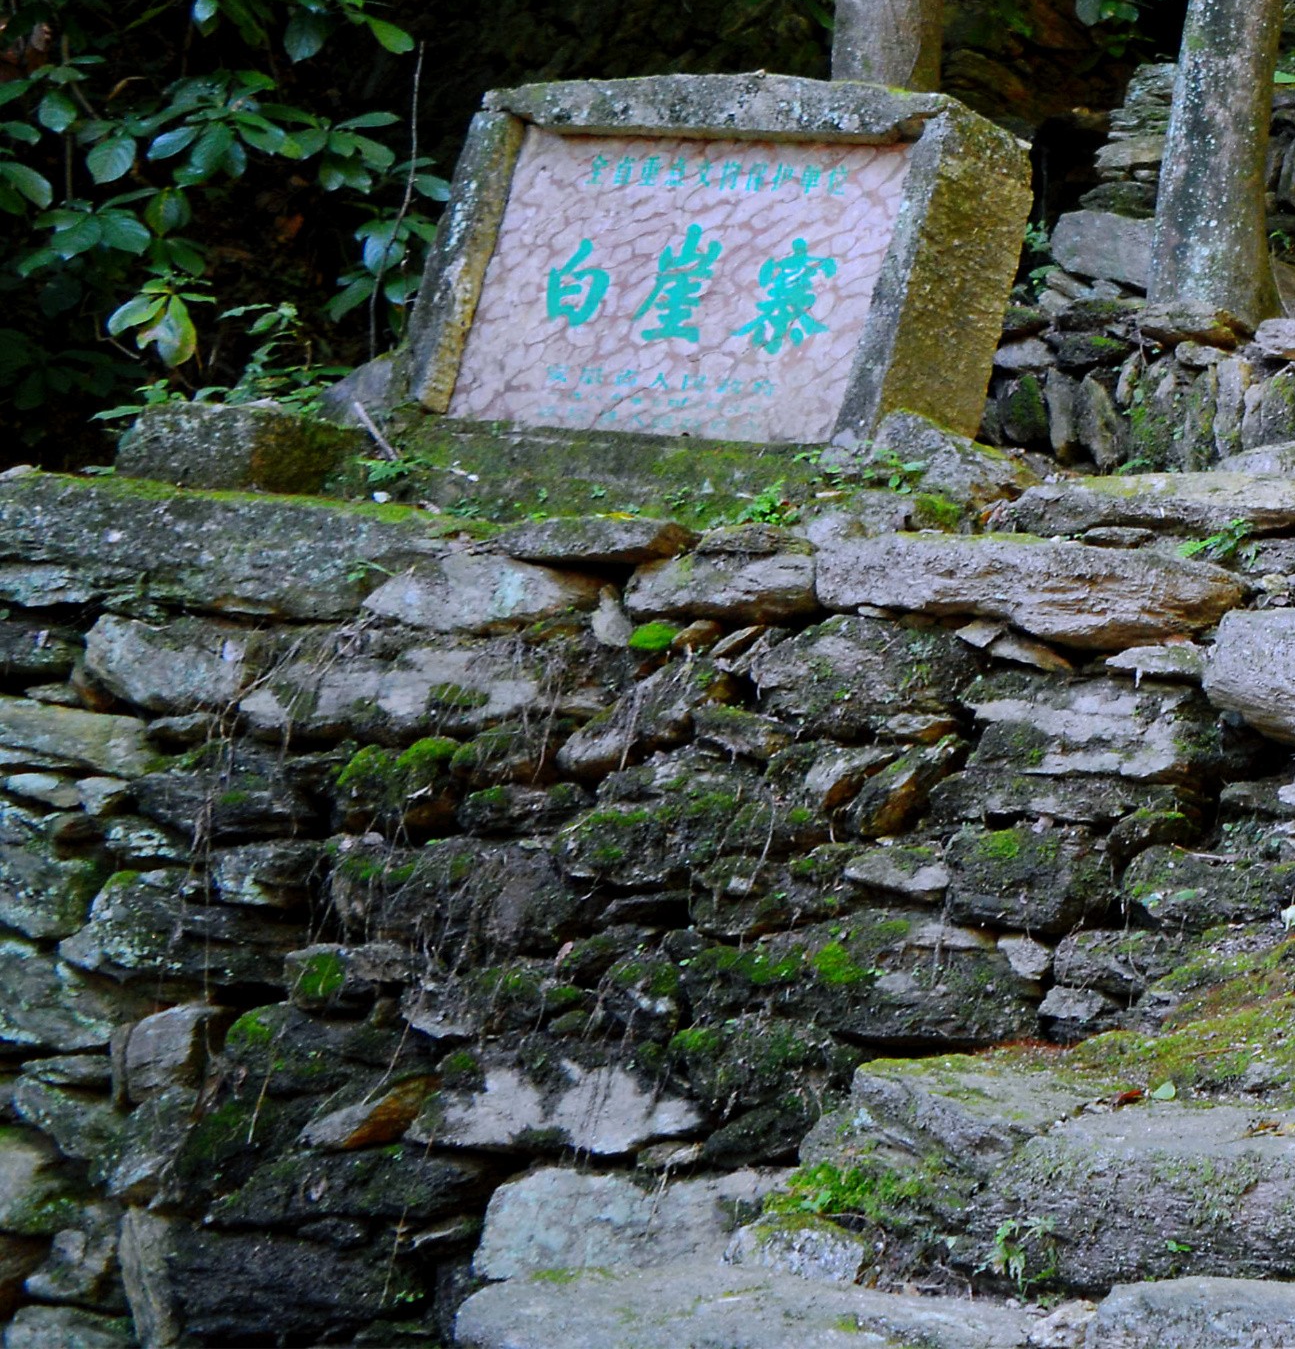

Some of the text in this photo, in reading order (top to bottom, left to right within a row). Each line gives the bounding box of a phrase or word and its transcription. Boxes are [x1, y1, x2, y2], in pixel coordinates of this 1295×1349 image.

[585, 153, 851, 196] 全省重点文物保护单位
[545, 223, 838, 356] 白崖寨
